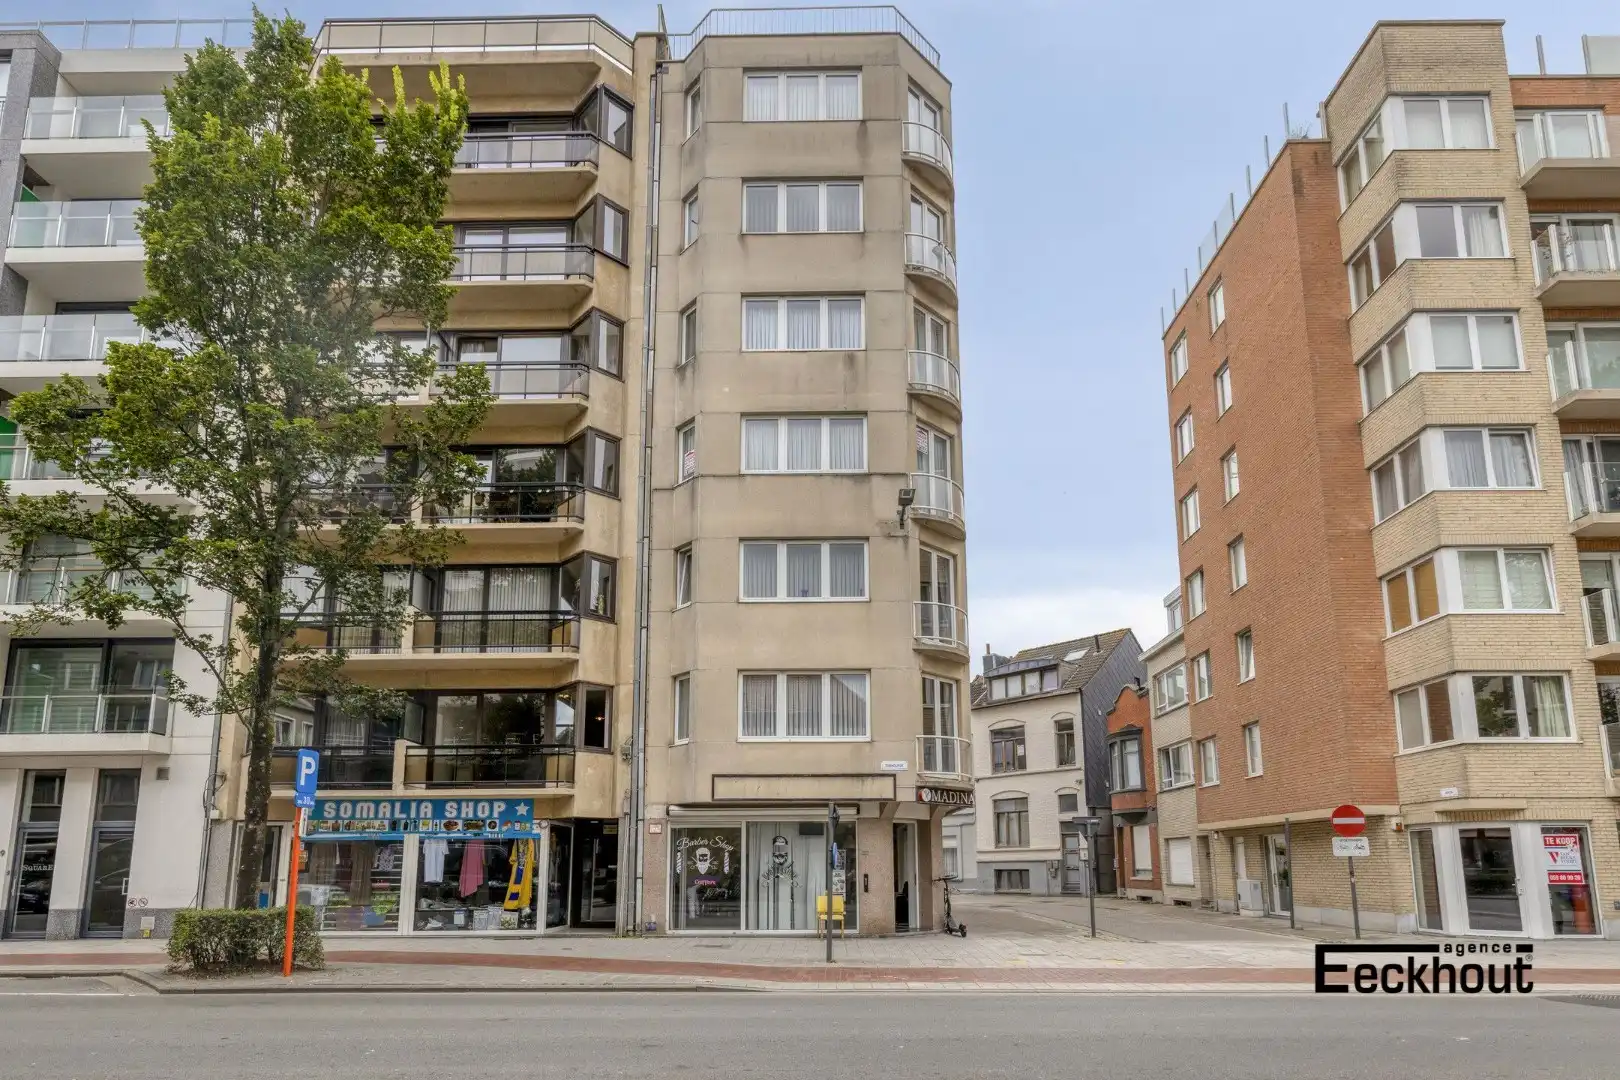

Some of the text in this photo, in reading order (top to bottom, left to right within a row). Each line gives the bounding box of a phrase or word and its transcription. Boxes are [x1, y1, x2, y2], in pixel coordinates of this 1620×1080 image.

[300, 756, 315, 785] P
[931, 789, 975, 805] MADINA
[323, 802, 506, 818] SOMALIA SHOP
[676, 835, 734, 851] Barber Shop
[1545, 837, 1575, 845] TE KOOP
